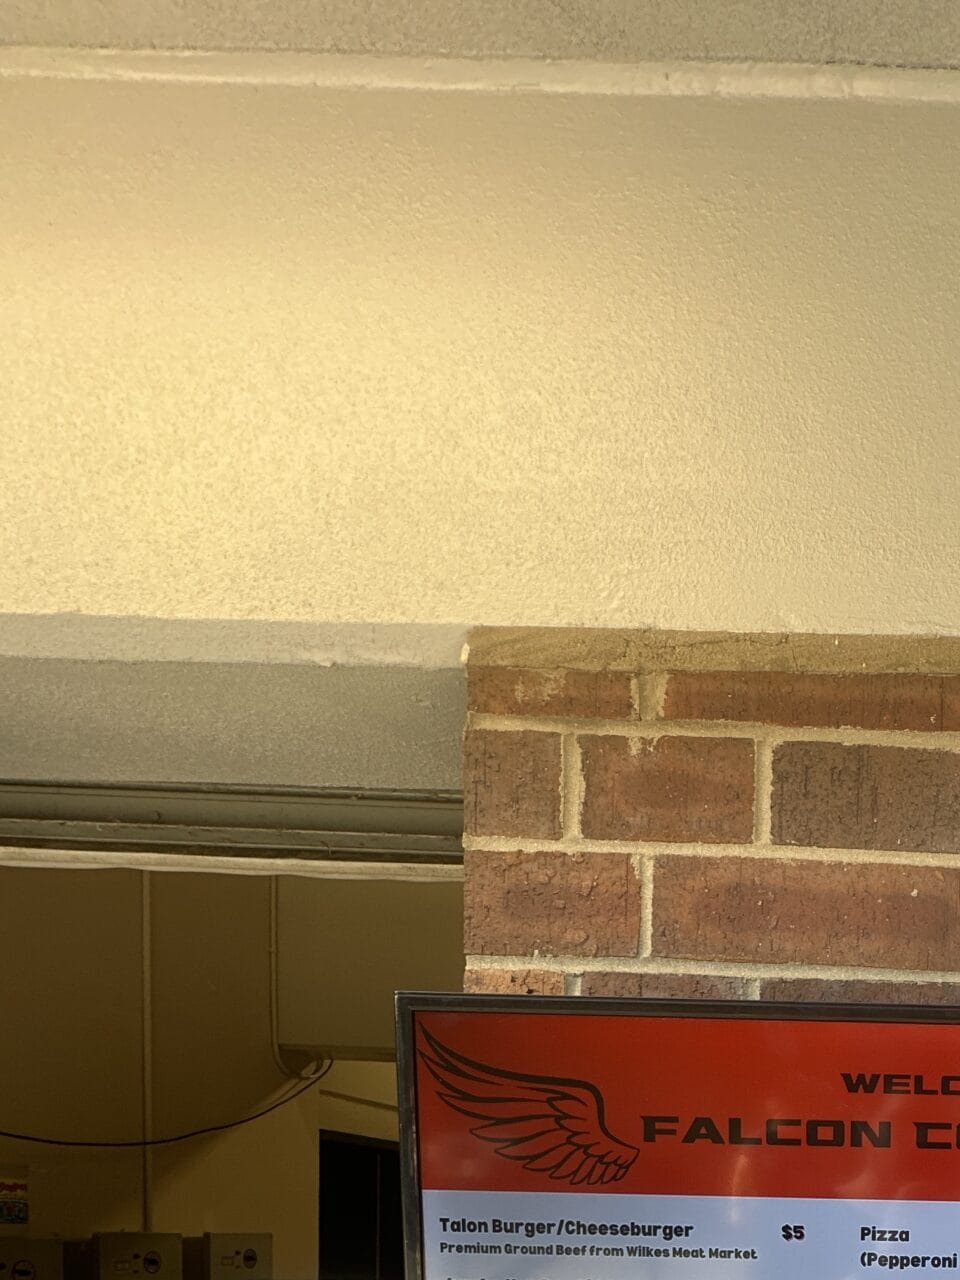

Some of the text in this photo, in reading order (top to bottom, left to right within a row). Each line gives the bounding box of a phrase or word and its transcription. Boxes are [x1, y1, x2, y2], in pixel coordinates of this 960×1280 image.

[641, 1116, 891, 1148] FALCON
[440, 1218, 693, 1240] Talon Burger/Cheeseburger
[781, 1225, 805, 1241] $5
[860, 1226, 910, 1241] Pizza
[440, 1242, 757, 1259] Premium Ground Beef from Wilkes Meat Market
[859, 1252, 958, 1269] (Pepperoni
